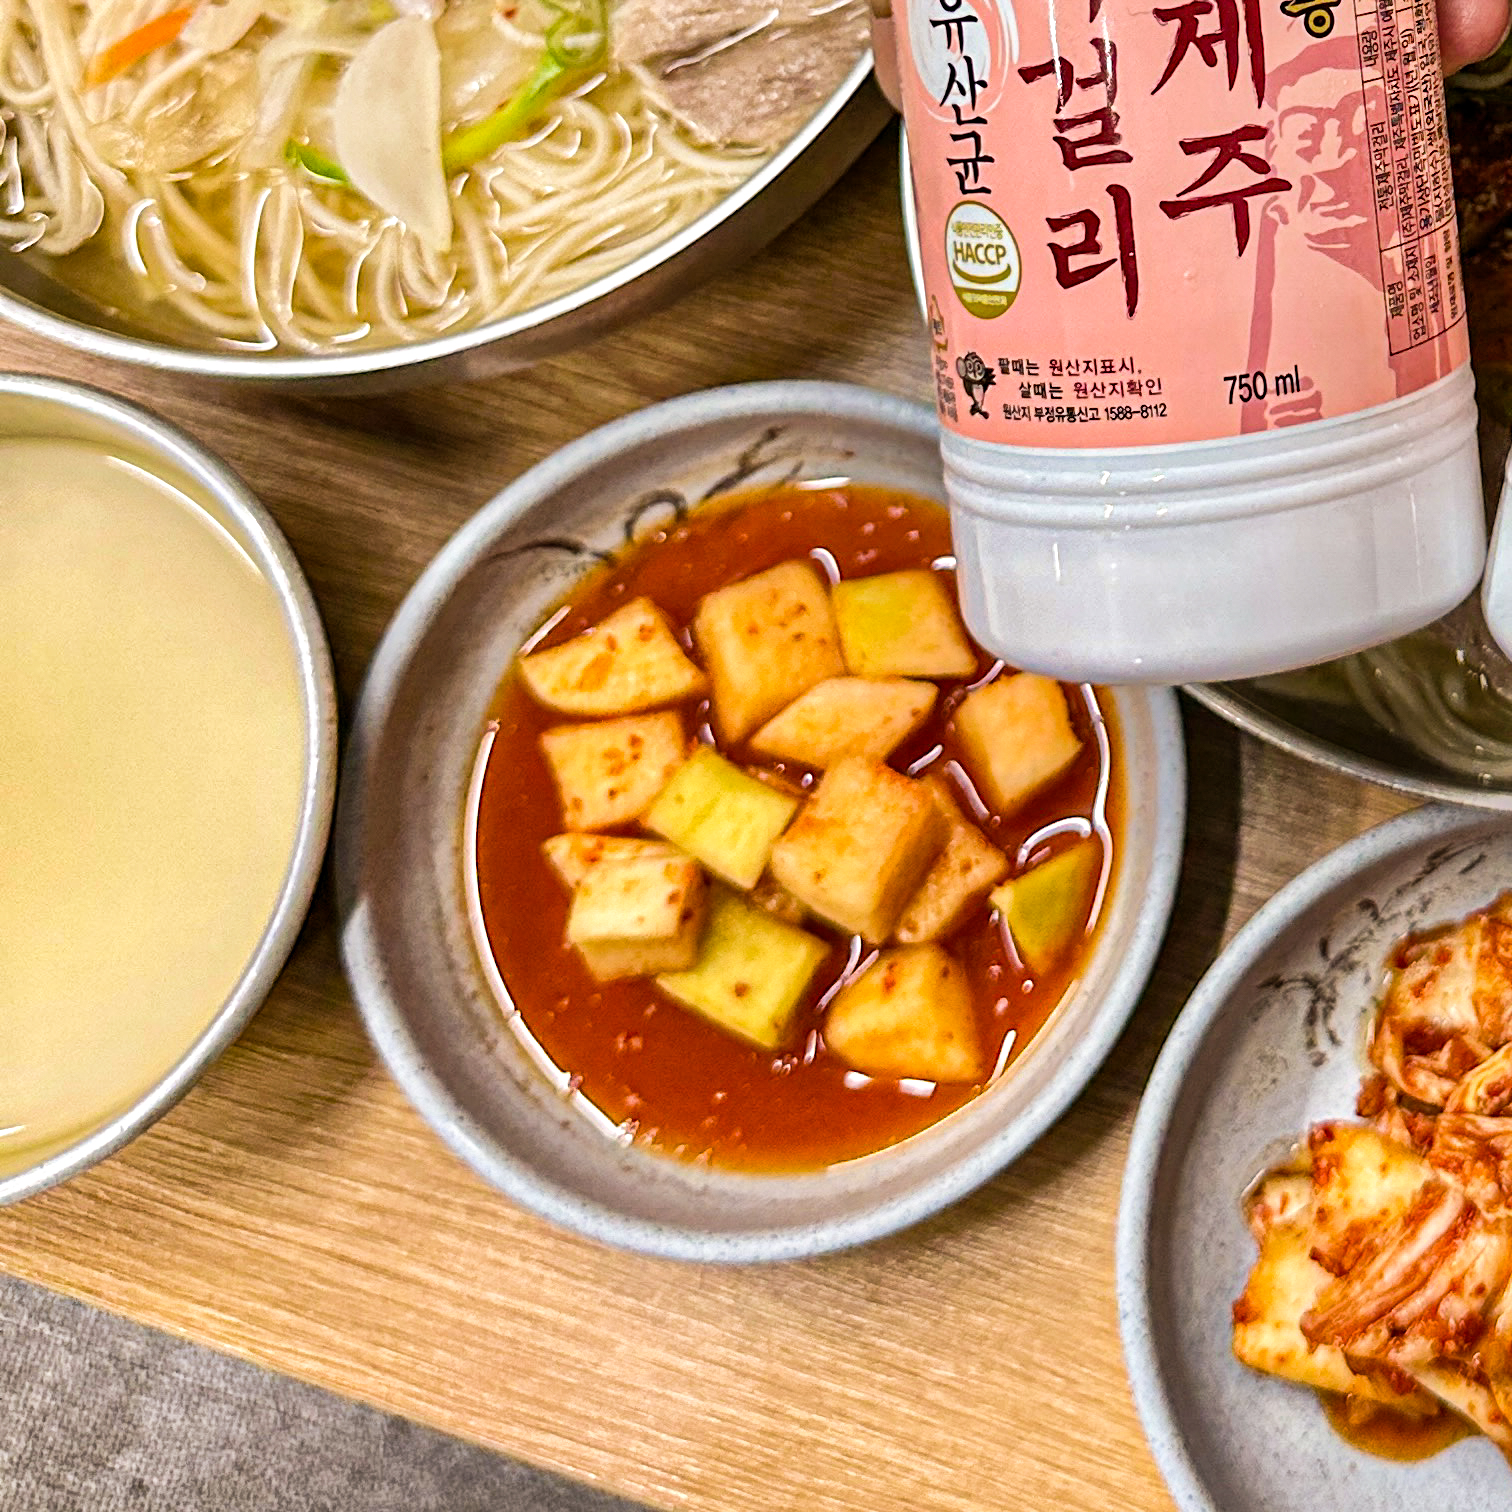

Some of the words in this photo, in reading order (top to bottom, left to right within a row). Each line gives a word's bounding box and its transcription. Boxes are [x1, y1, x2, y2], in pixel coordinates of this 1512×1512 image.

[1359, 29, 1380, 67] 내용량
[1381, 23, 1399, 62] 제주시
[1368, 120, 1395, 211] 전통제주막걸리
[953, 242, 1008, 266] HACCP
[1019, 382, 1063, 400] 살때는
[1073, 377, 1163, 399] 원산지확인
[1224, 373, 1268, 405] 750
[1275, 365, 1302, 396] ml
[1002, 403, 1031, 421] 원산지
[1104, 402, 1168, 421] 1588-8112
